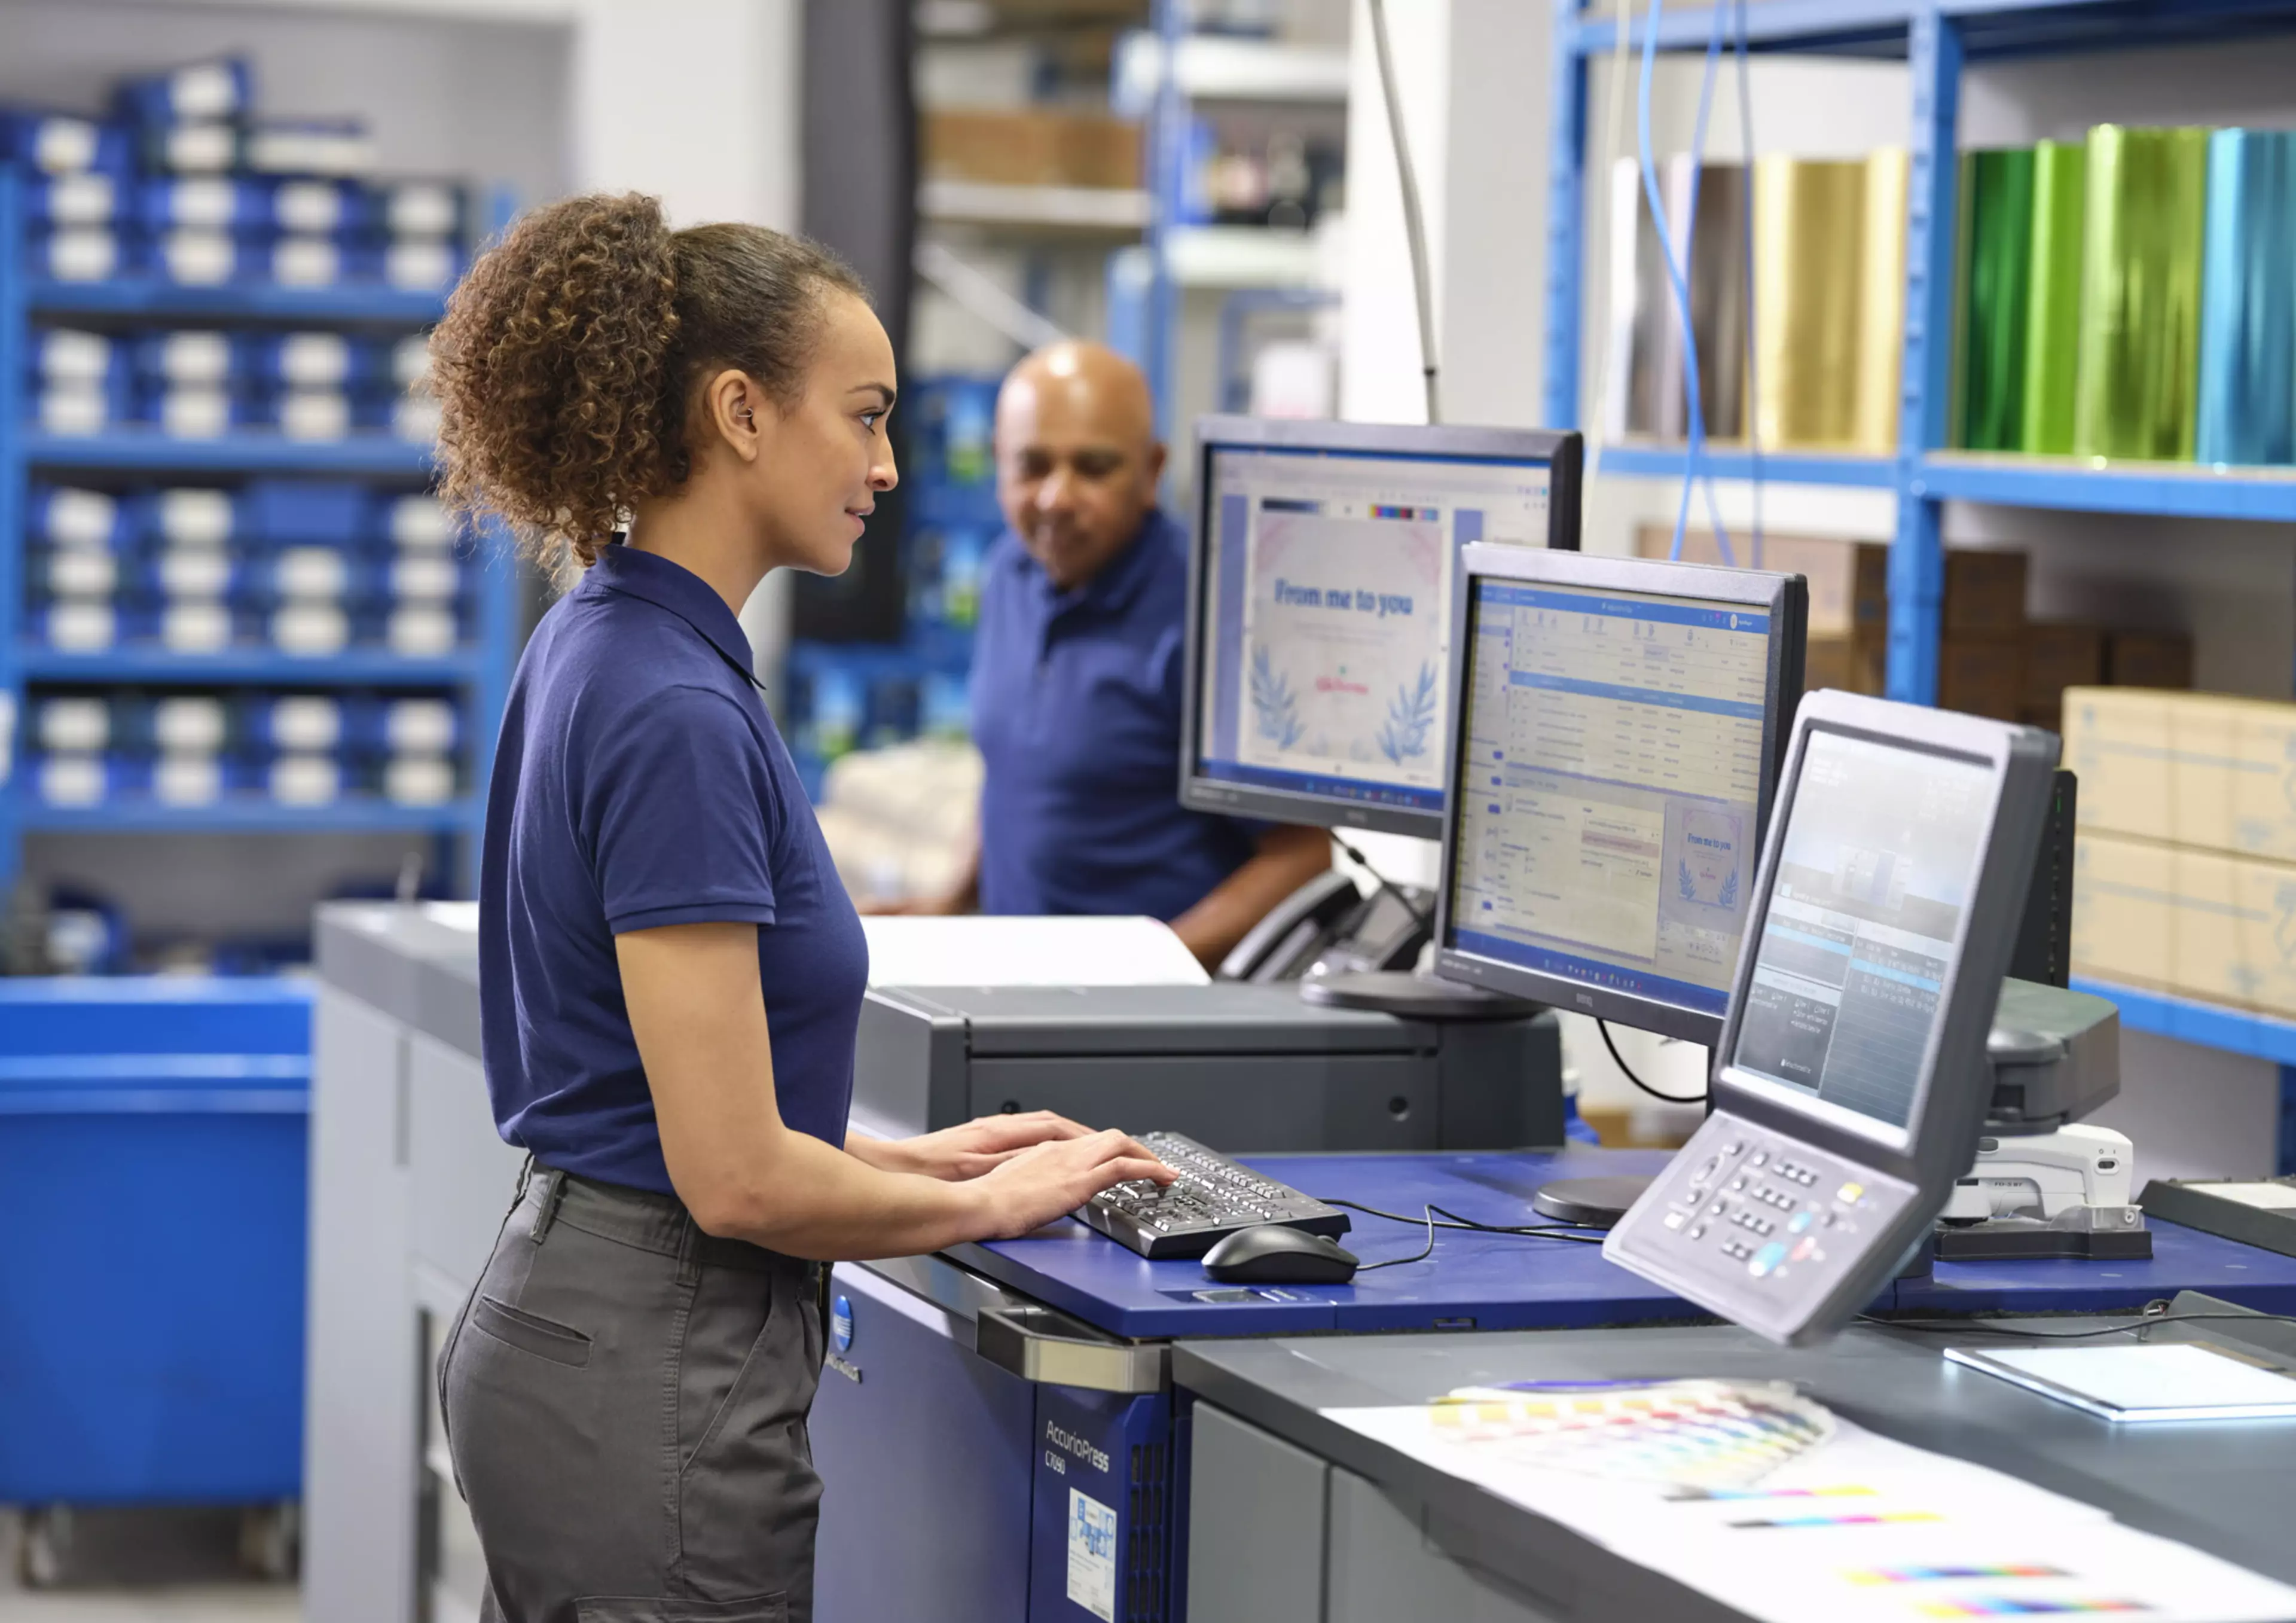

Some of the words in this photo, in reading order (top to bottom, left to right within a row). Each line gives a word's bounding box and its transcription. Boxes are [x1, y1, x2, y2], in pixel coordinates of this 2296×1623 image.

[1275, 578, 1322, 607] From
[1355, 587, 1375, 612] to
[1377, 593, 1413, 620] you
[1688, 833, 1702, 844] From
[1703, 838, 1712, 847] me
[1713, 838, 1720, 848] to
[1720, 841, 1731, 851] you
[1046, 1419, 1110, 1474] AccurioPress
